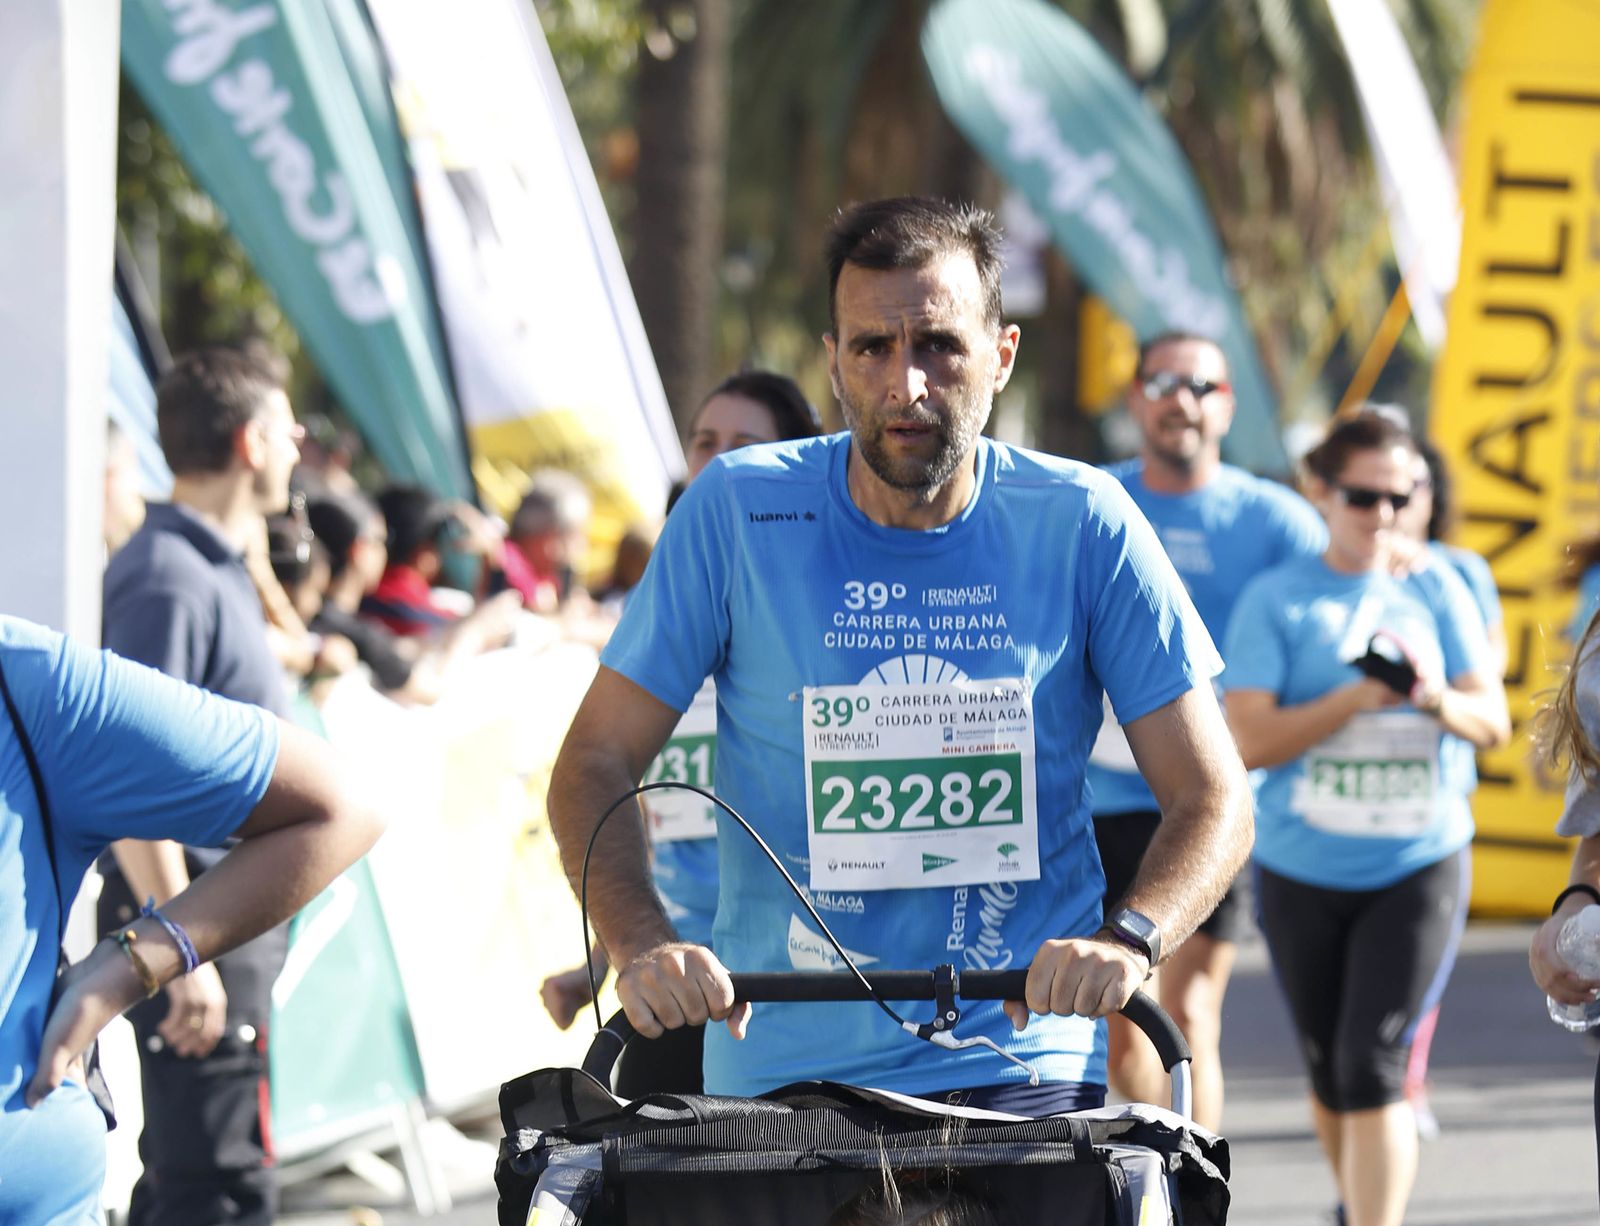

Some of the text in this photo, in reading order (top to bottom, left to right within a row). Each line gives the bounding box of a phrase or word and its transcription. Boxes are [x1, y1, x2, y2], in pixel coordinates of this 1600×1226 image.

[750, 512, 798, 523] luanvi
[929, 584, 991, 600] RENAULT
[833, 612, 1007, 630] CARRERA URBANA
[824, 631, 1015, 651] CIUDAD DE MÁLAGA
[881, 694, 952, 708] CARRERA
[959, 690, 1020, 706] URBANA
[875, 708, 1028, 727] CIUDAD DE MÁLAGA
[819, 732, 874, 742] RENAULT
[942, 743, 1017, 754] MINI CARRERA
[821, 769, 1013, 830] 23282
[841, 861, 886, 870] RENAULT
[947, 886, 968, 951] Rena
